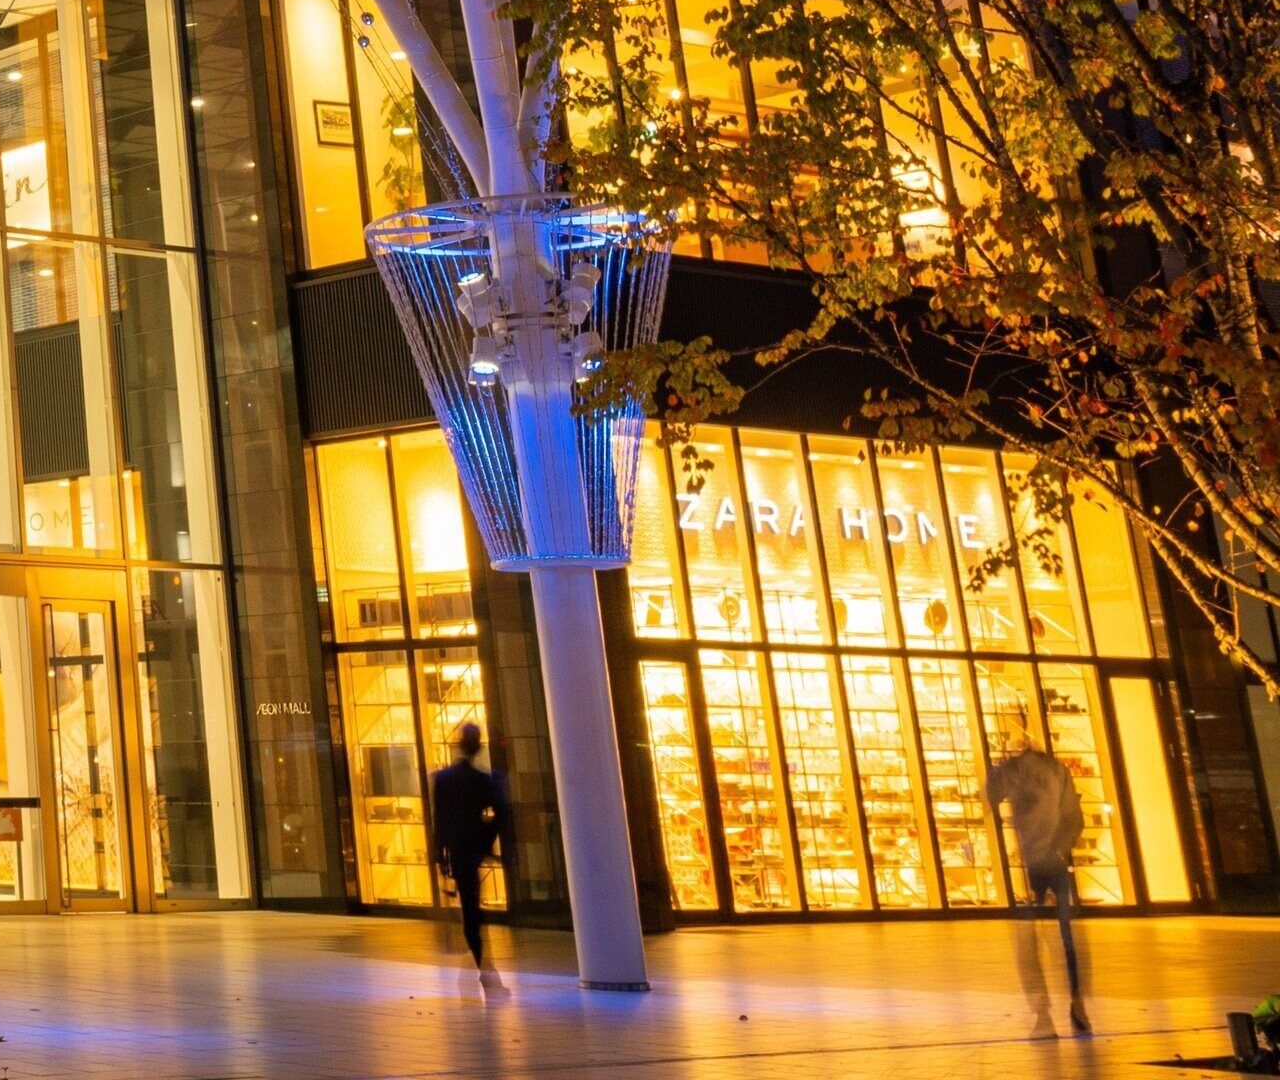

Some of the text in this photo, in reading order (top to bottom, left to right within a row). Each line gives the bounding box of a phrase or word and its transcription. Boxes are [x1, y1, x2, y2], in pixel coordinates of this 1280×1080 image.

[29, 506, 92, 531] OME
[676, 494, 985, 549] ZARA HOME
[283, 702, 311, 714] MALL
